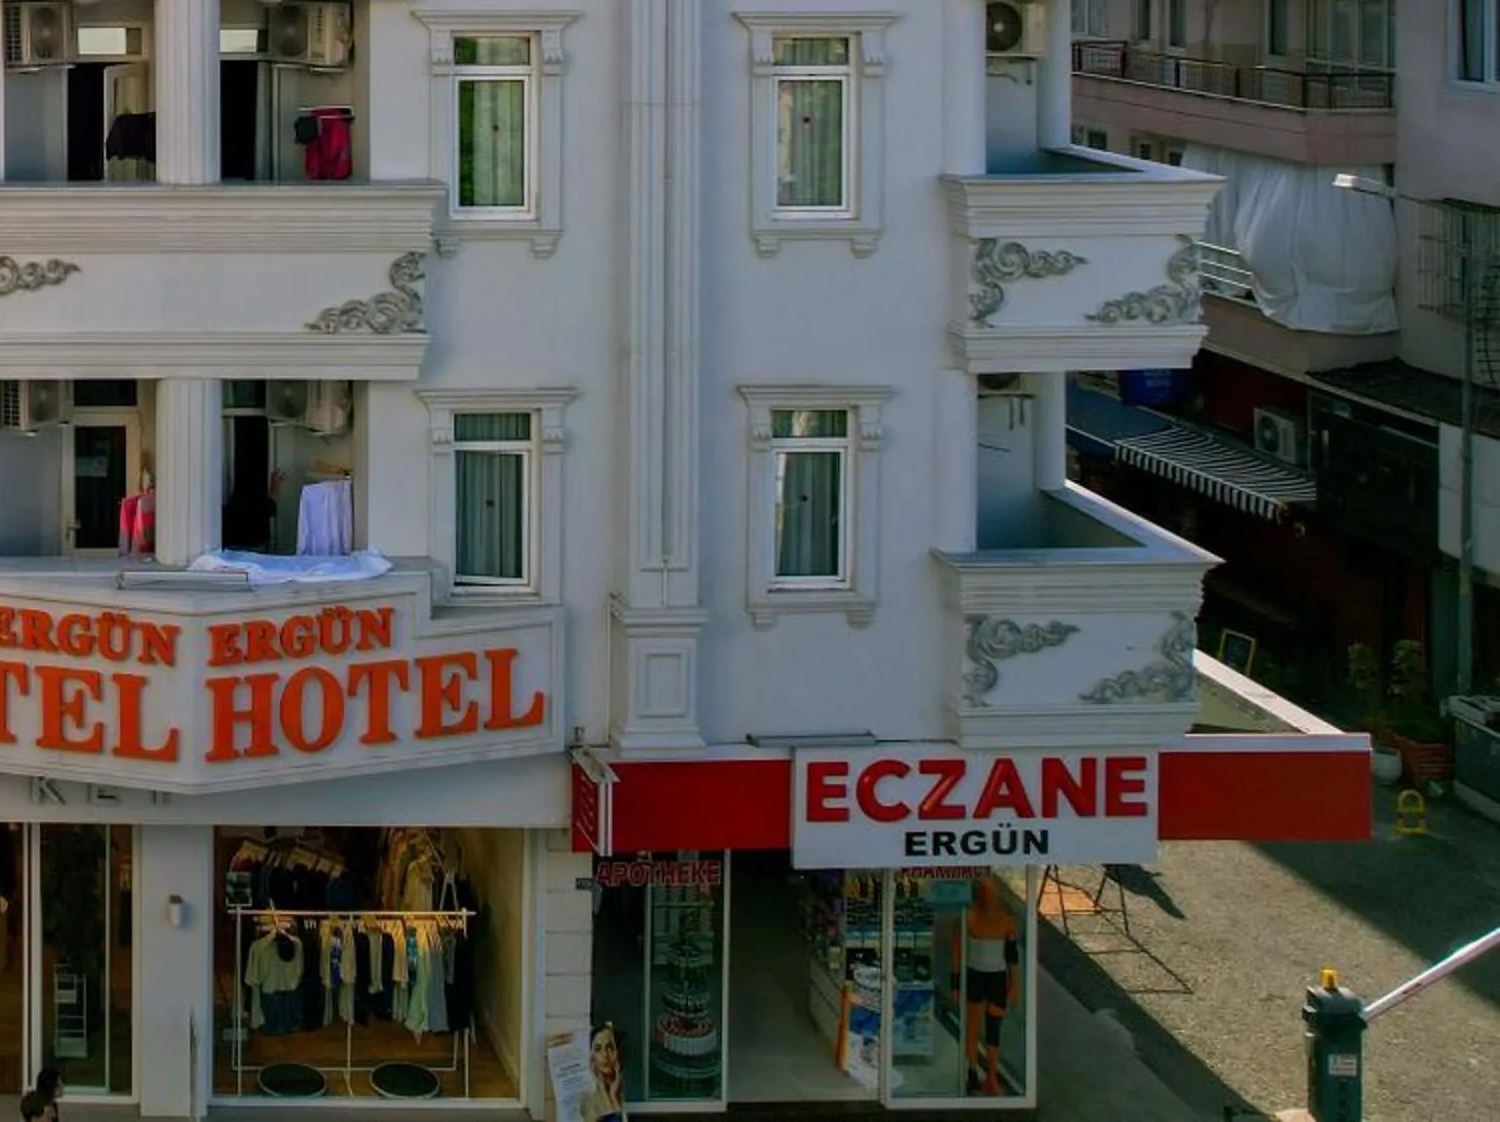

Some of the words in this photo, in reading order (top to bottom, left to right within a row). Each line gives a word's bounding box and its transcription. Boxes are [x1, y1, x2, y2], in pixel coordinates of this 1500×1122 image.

[206, 605, 395, 668] ERGÜN
[205, 647, 545, 763] HOTEL
[806, 757, 1148, 823] ECZANE
[904, 823, 1050, 857] ERGÜN
[596, 861, 721, 888] APOTHEKE
